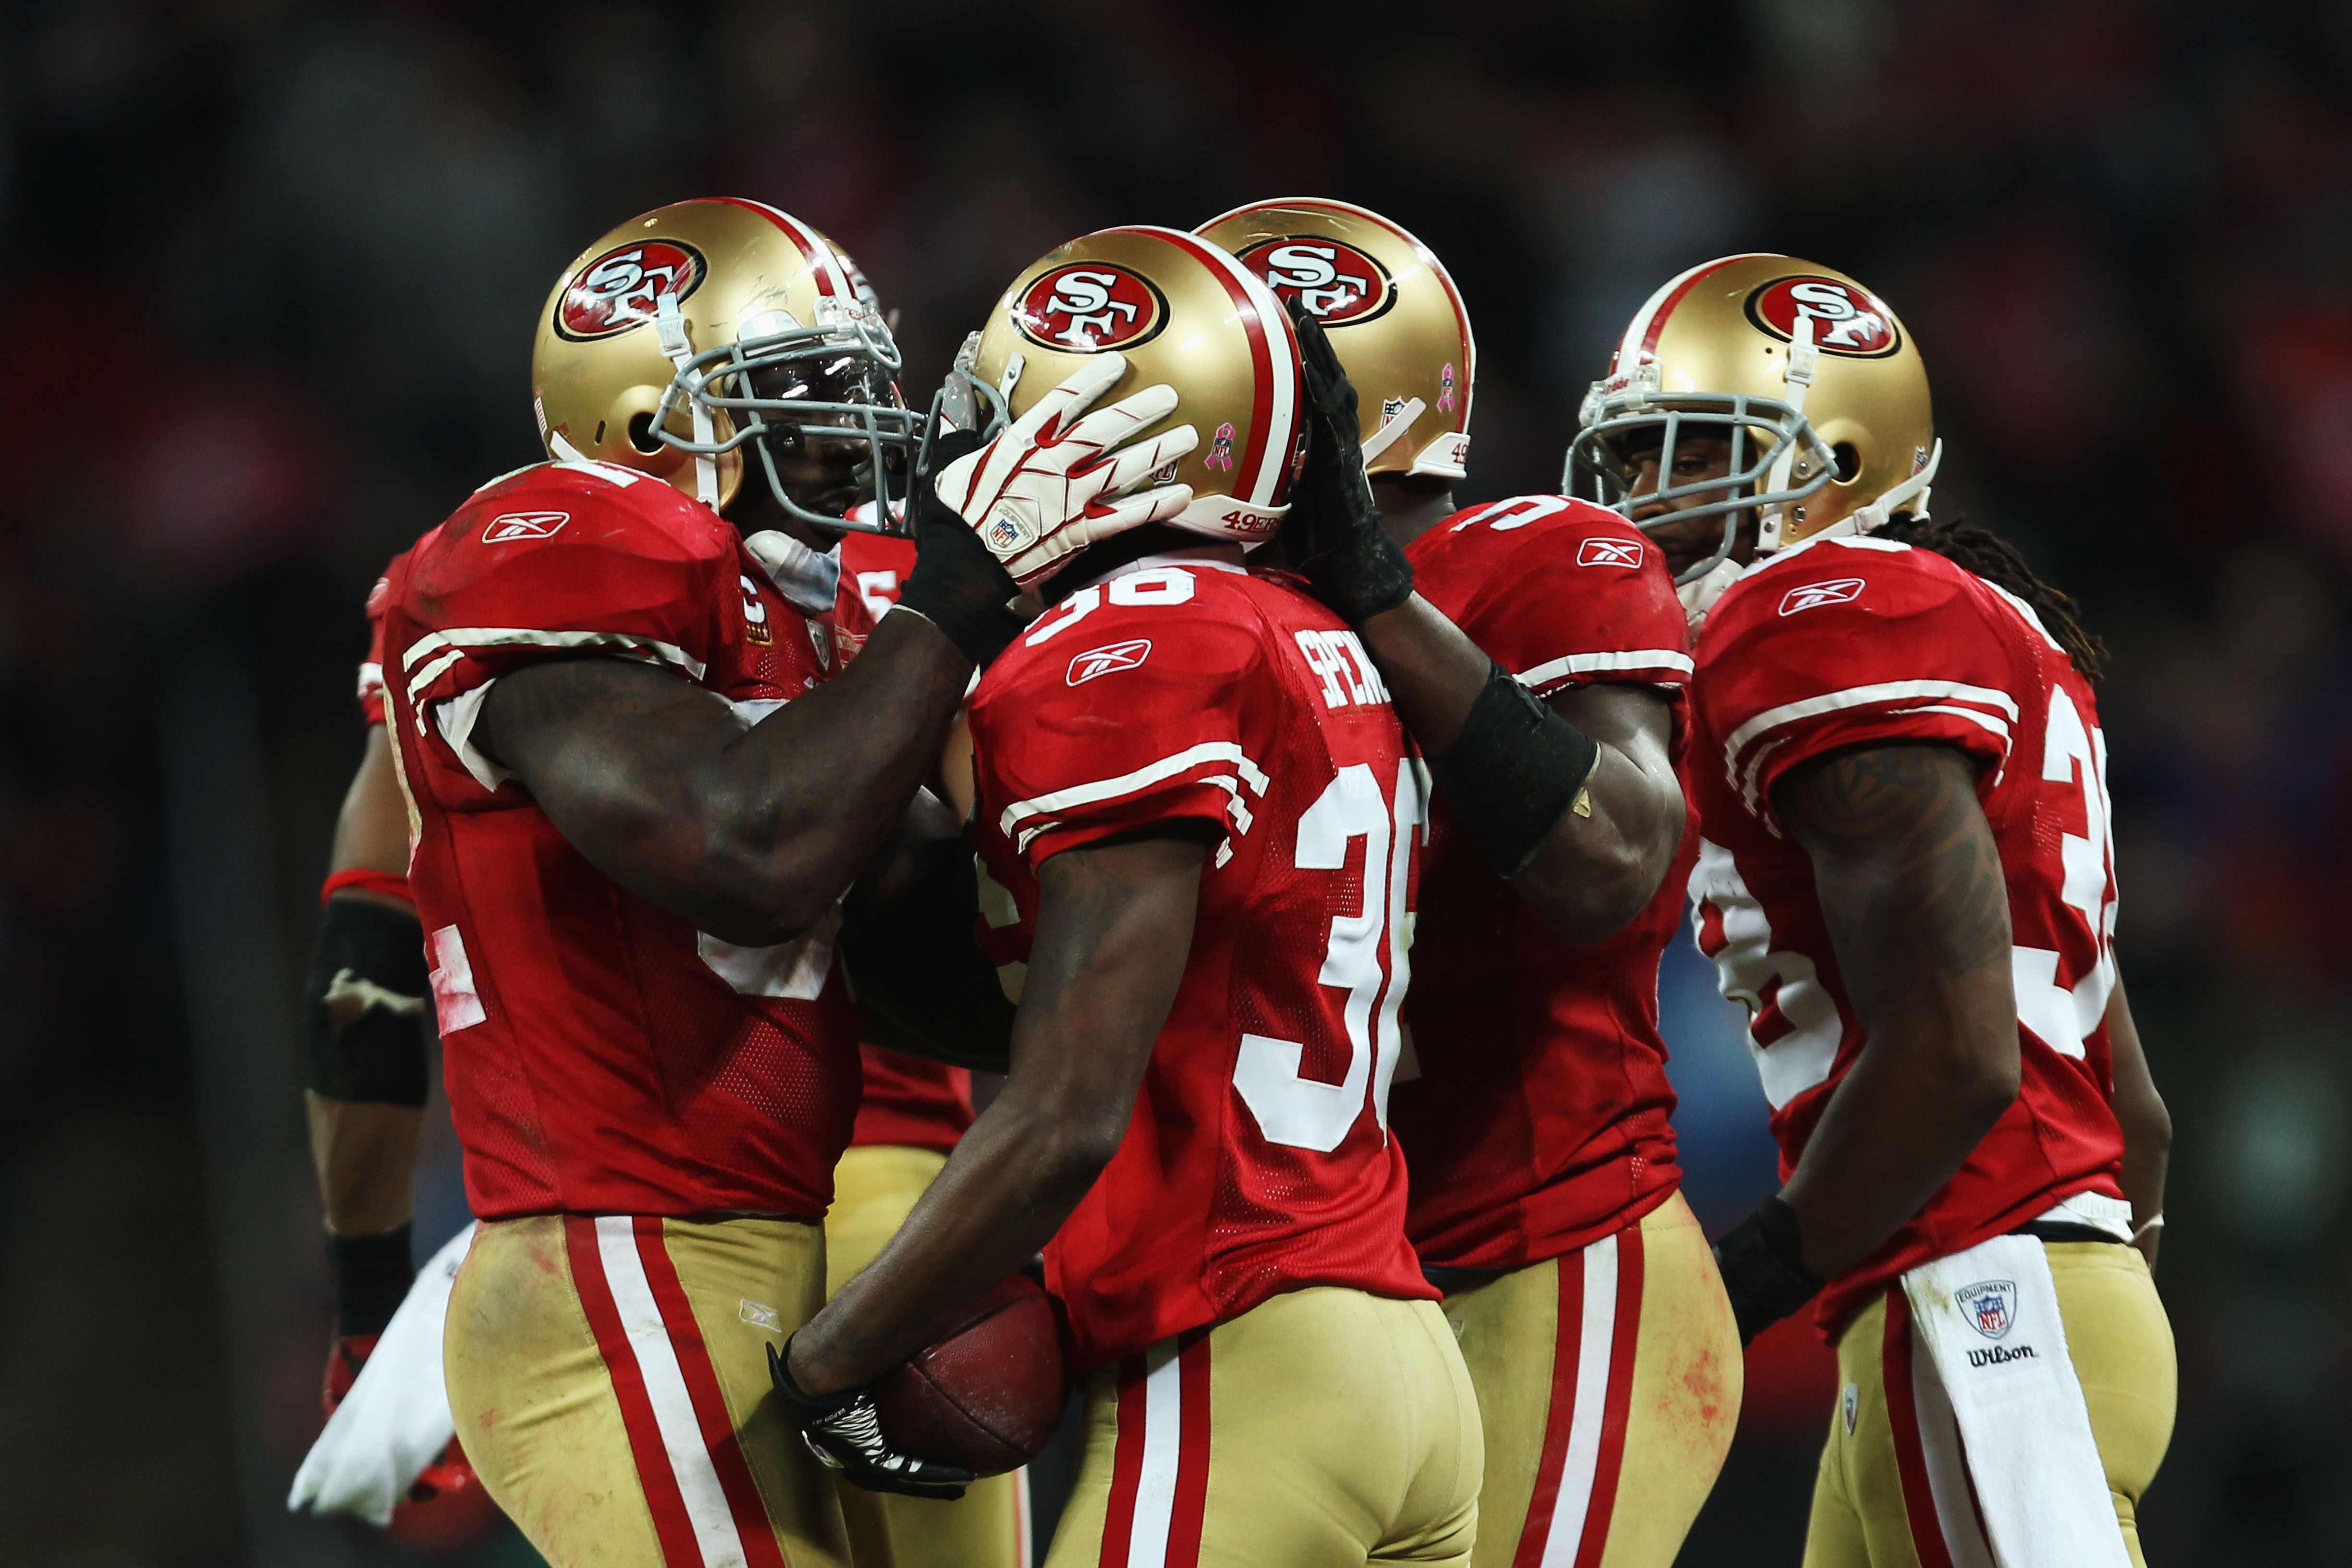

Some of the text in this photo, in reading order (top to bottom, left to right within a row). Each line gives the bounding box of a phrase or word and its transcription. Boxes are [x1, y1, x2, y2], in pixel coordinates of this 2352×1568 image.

[584, 249, 673, 327] SF
[1267, 245, 1366, 316] SF
[1046, 271, 1137, 341] SF
[1790, 283, 1882, 346] SF
[992, 527, 1009, 547] NFL
[740, 575, 766, 623] C
[1959, 1283, 2012, 1302] EQUIPMENT
[1979, 1311, 2006, 1330] NFL
[1967, 1346, 2037, 1367] Wilson
